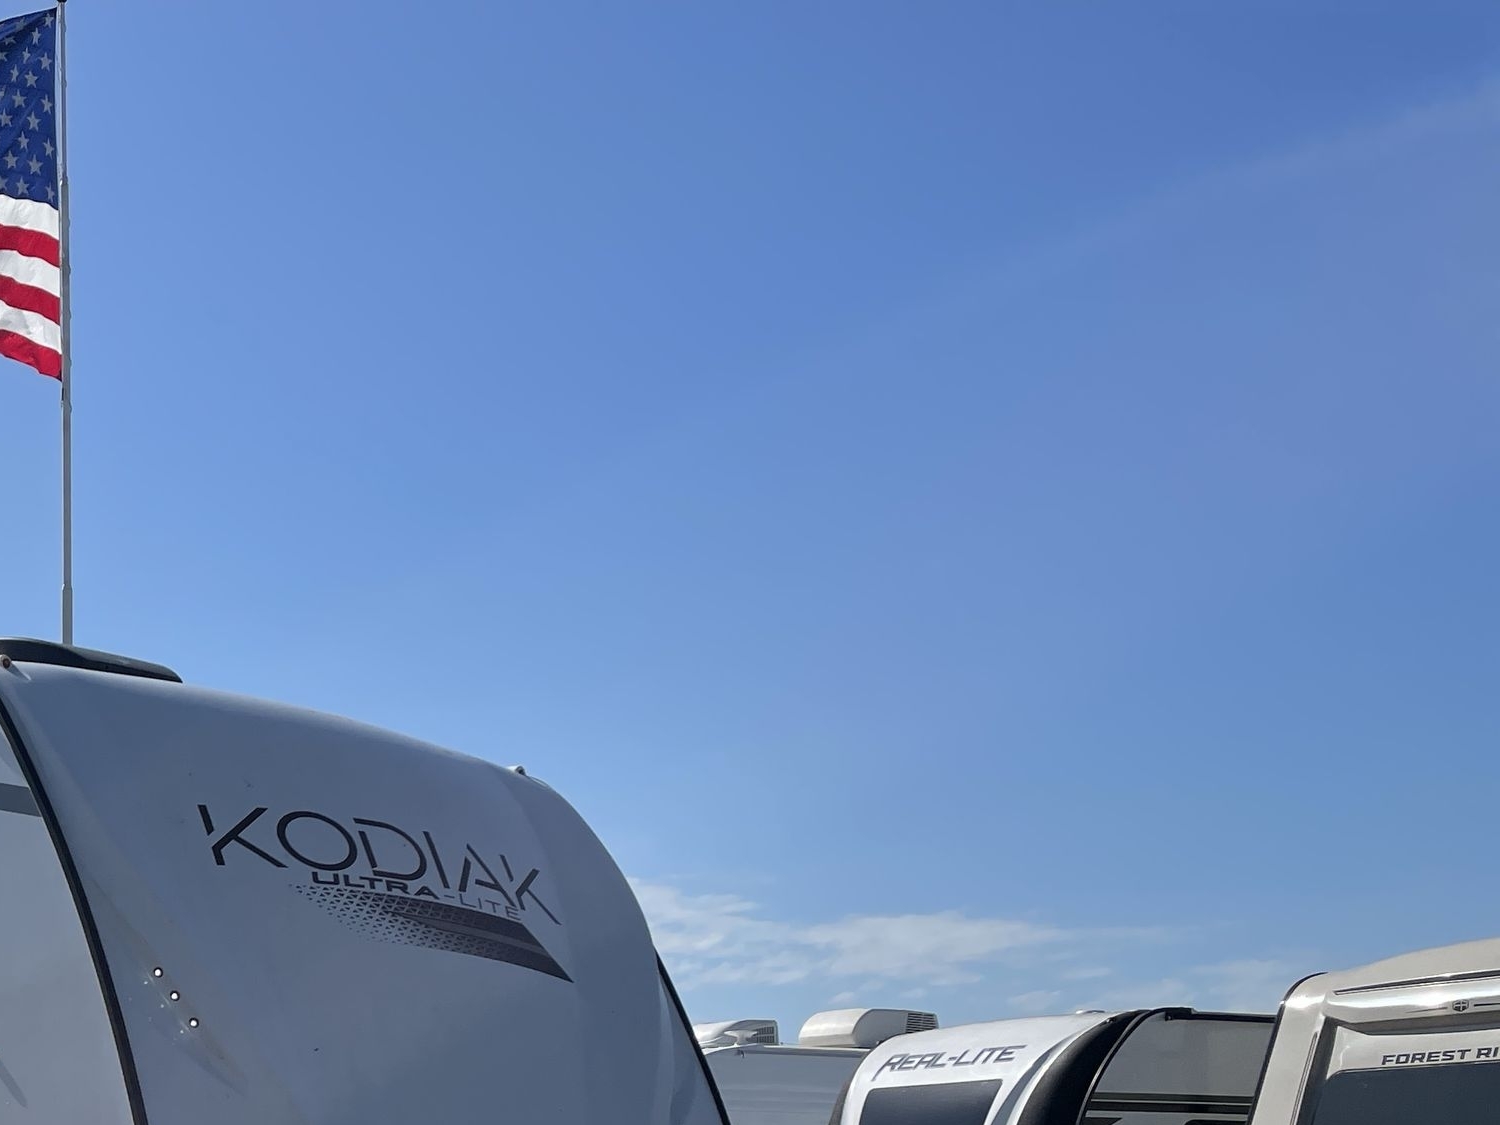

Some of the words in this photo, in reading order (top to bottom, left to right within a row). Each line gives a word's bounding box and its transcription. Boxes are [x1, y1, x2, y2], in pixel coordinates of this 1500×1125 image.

[197, 803, 562, 926] KODIAK
[311, 871, 521, 921] ULTRA-LITE
[871, 1044, 1028, 1082] REAL-LITE
[1381, 1049, 1472, 1065] FOREST
